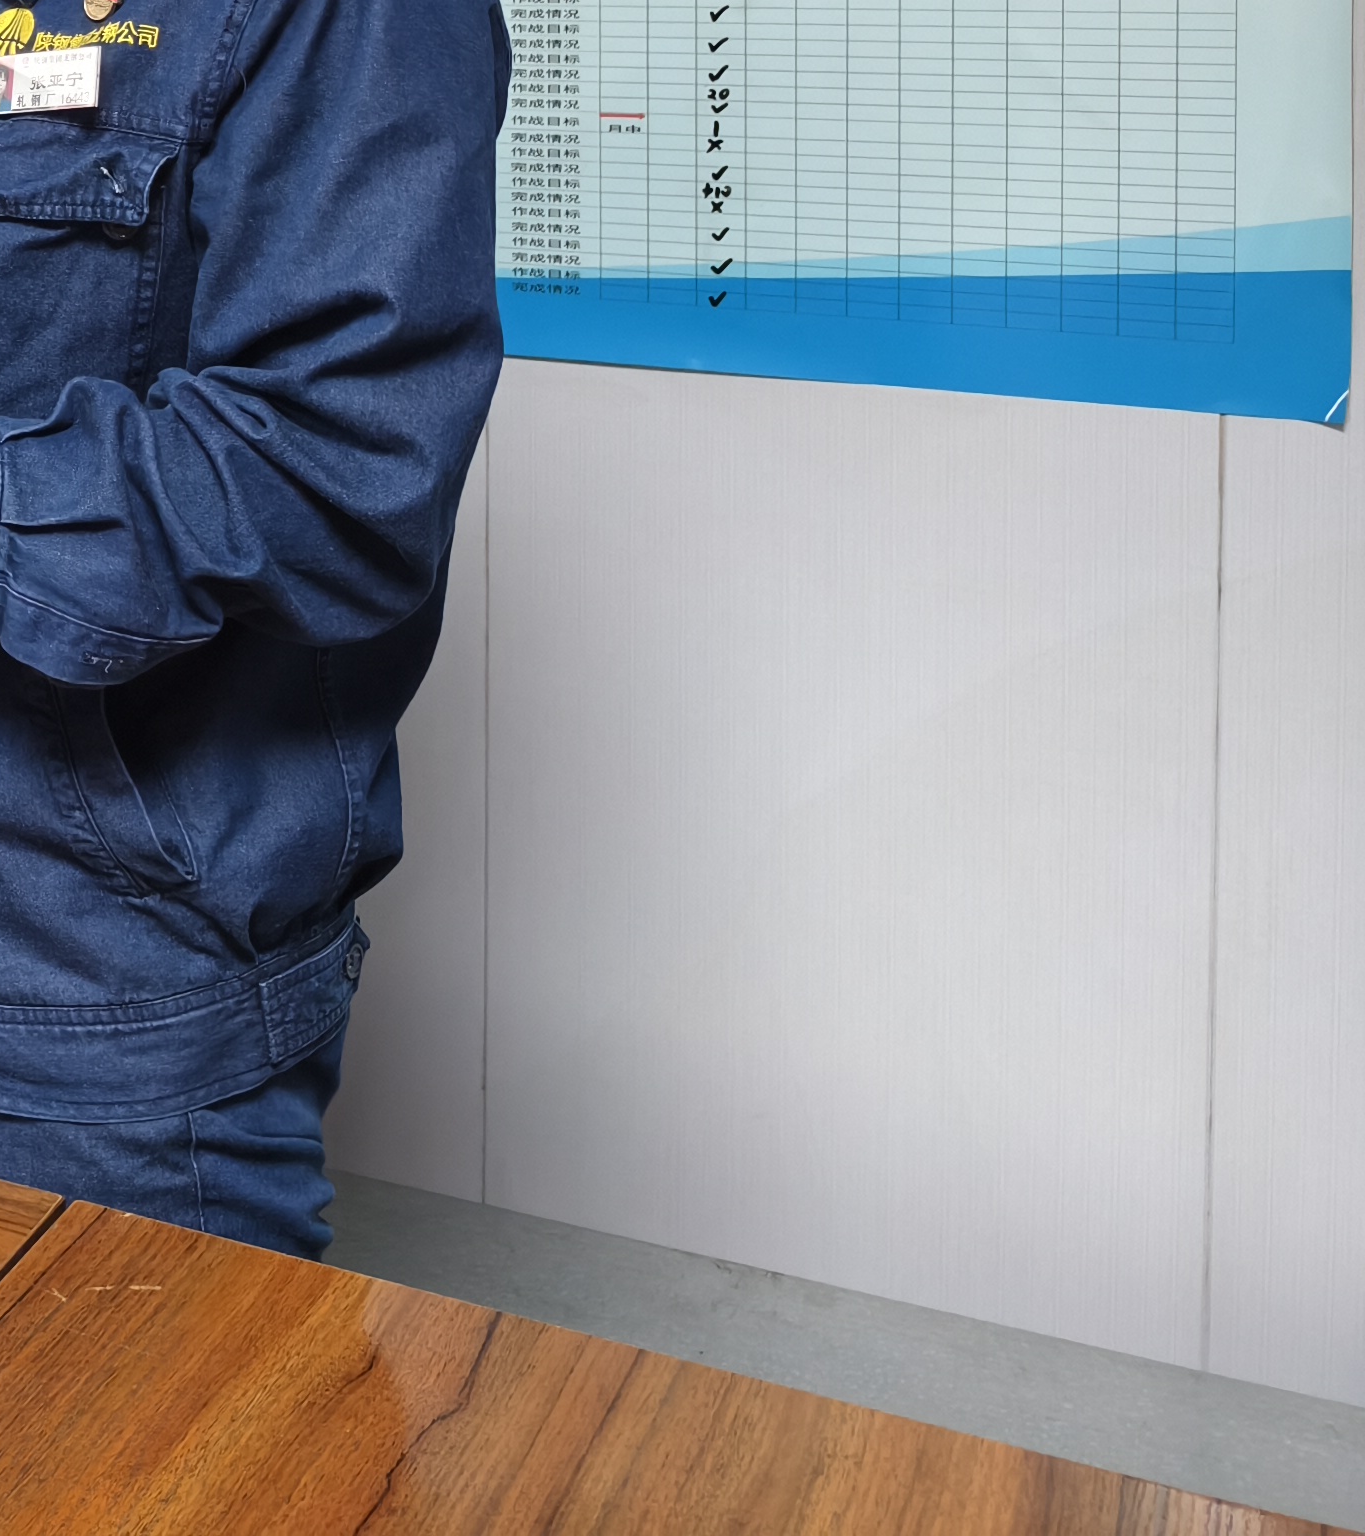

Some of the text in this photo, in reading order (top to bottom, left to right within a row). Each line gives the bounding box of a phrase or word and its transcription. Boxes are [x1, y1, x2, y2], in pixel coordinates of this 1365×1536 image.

[511, 7, 579, 21] 完成情况
[511, 36, 579, 51] 完成情况
[511, 66, 579, 81] 完成情况
[511, 96, 579, 111] 完成情况
[609, 124, 641, 133] 月中
[511, 130, 579, 146] 完成情况
[511, 160, 580, 175] 完成情况
[511, 189, 580, 205] 完成情况
[511, 220, 580, 236] 完成情况
[511, 249, 580, 266] 完成情况
[511, 280, 580, 297] 完成情况
